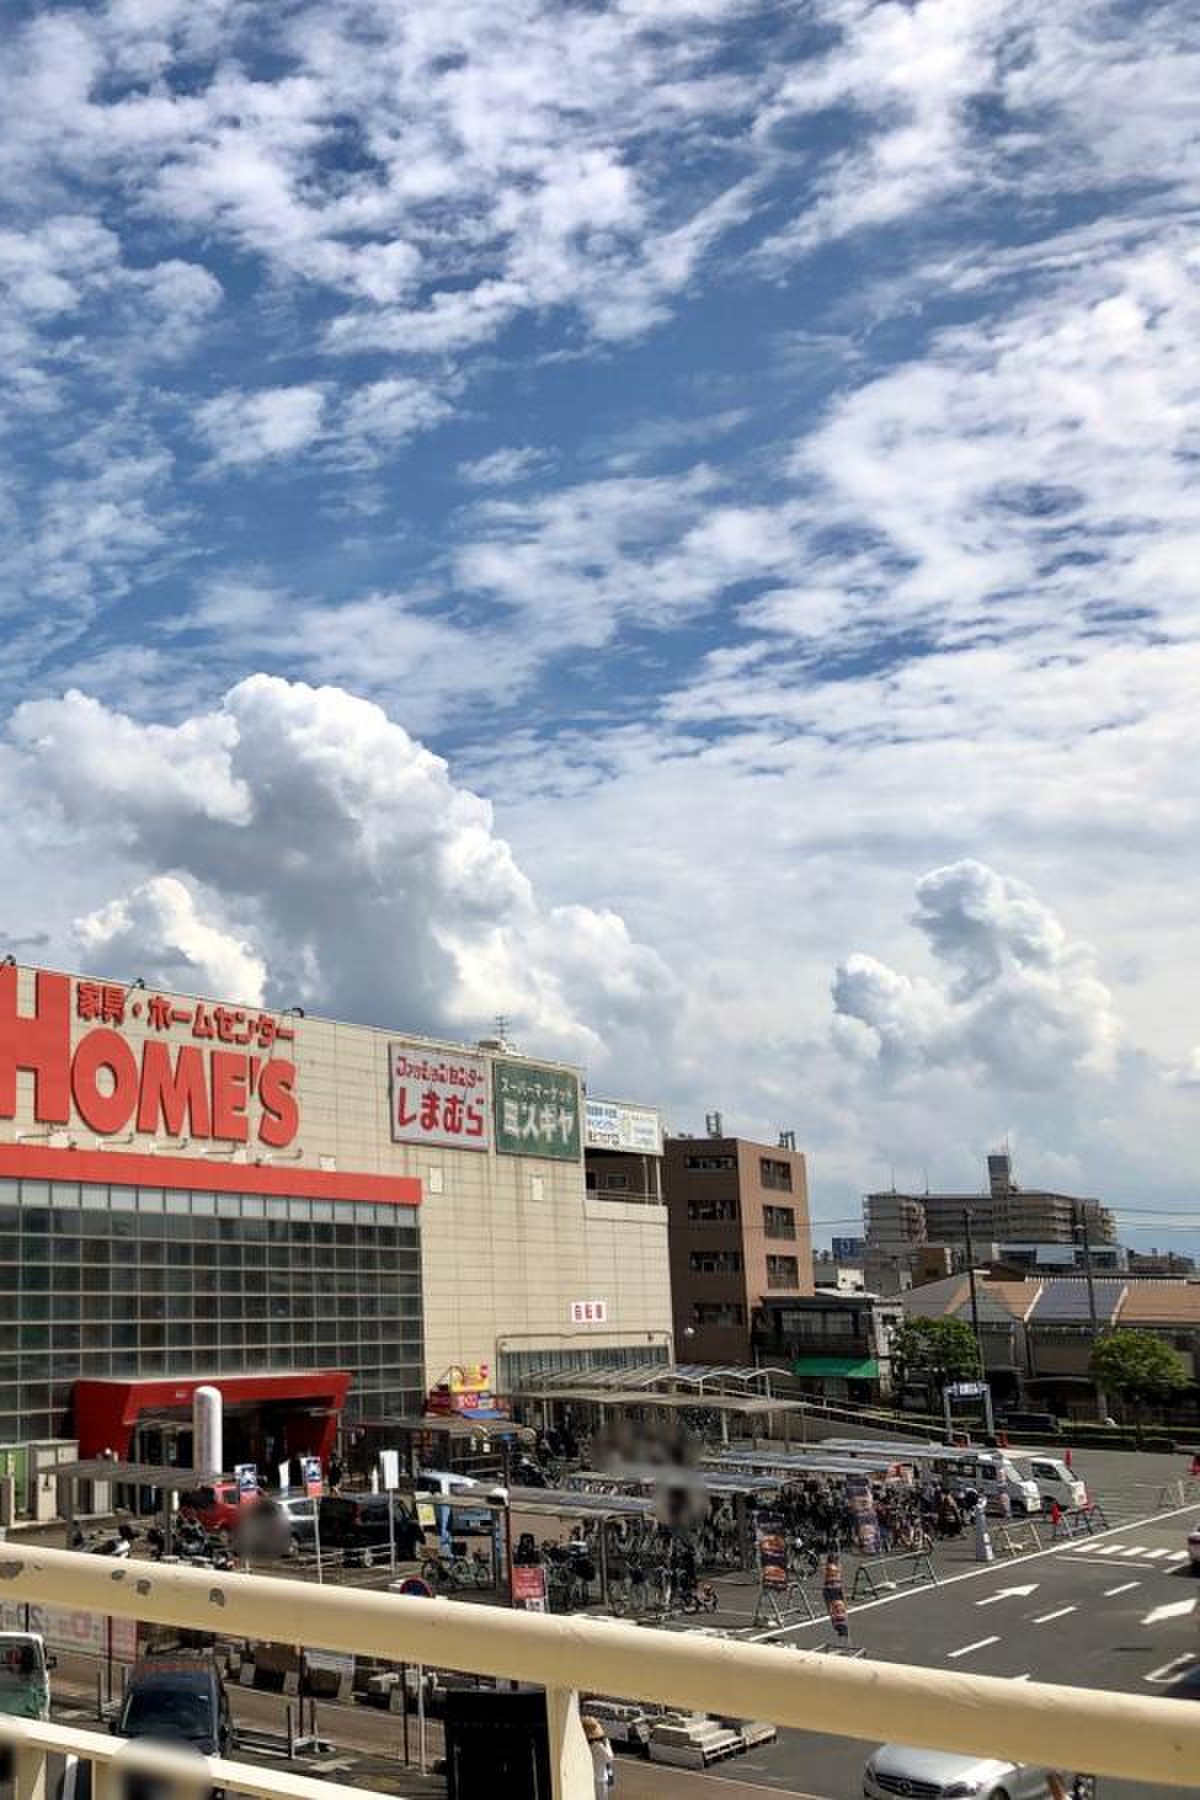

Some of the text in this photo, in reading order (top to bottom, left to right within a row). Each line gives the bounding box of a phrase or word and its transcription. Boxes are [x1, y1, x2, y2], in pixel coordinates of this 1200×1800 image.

[77, 982, 296, 1047] 家具・ホームセンター
[398, 1087, 485, 1136] しまむら
